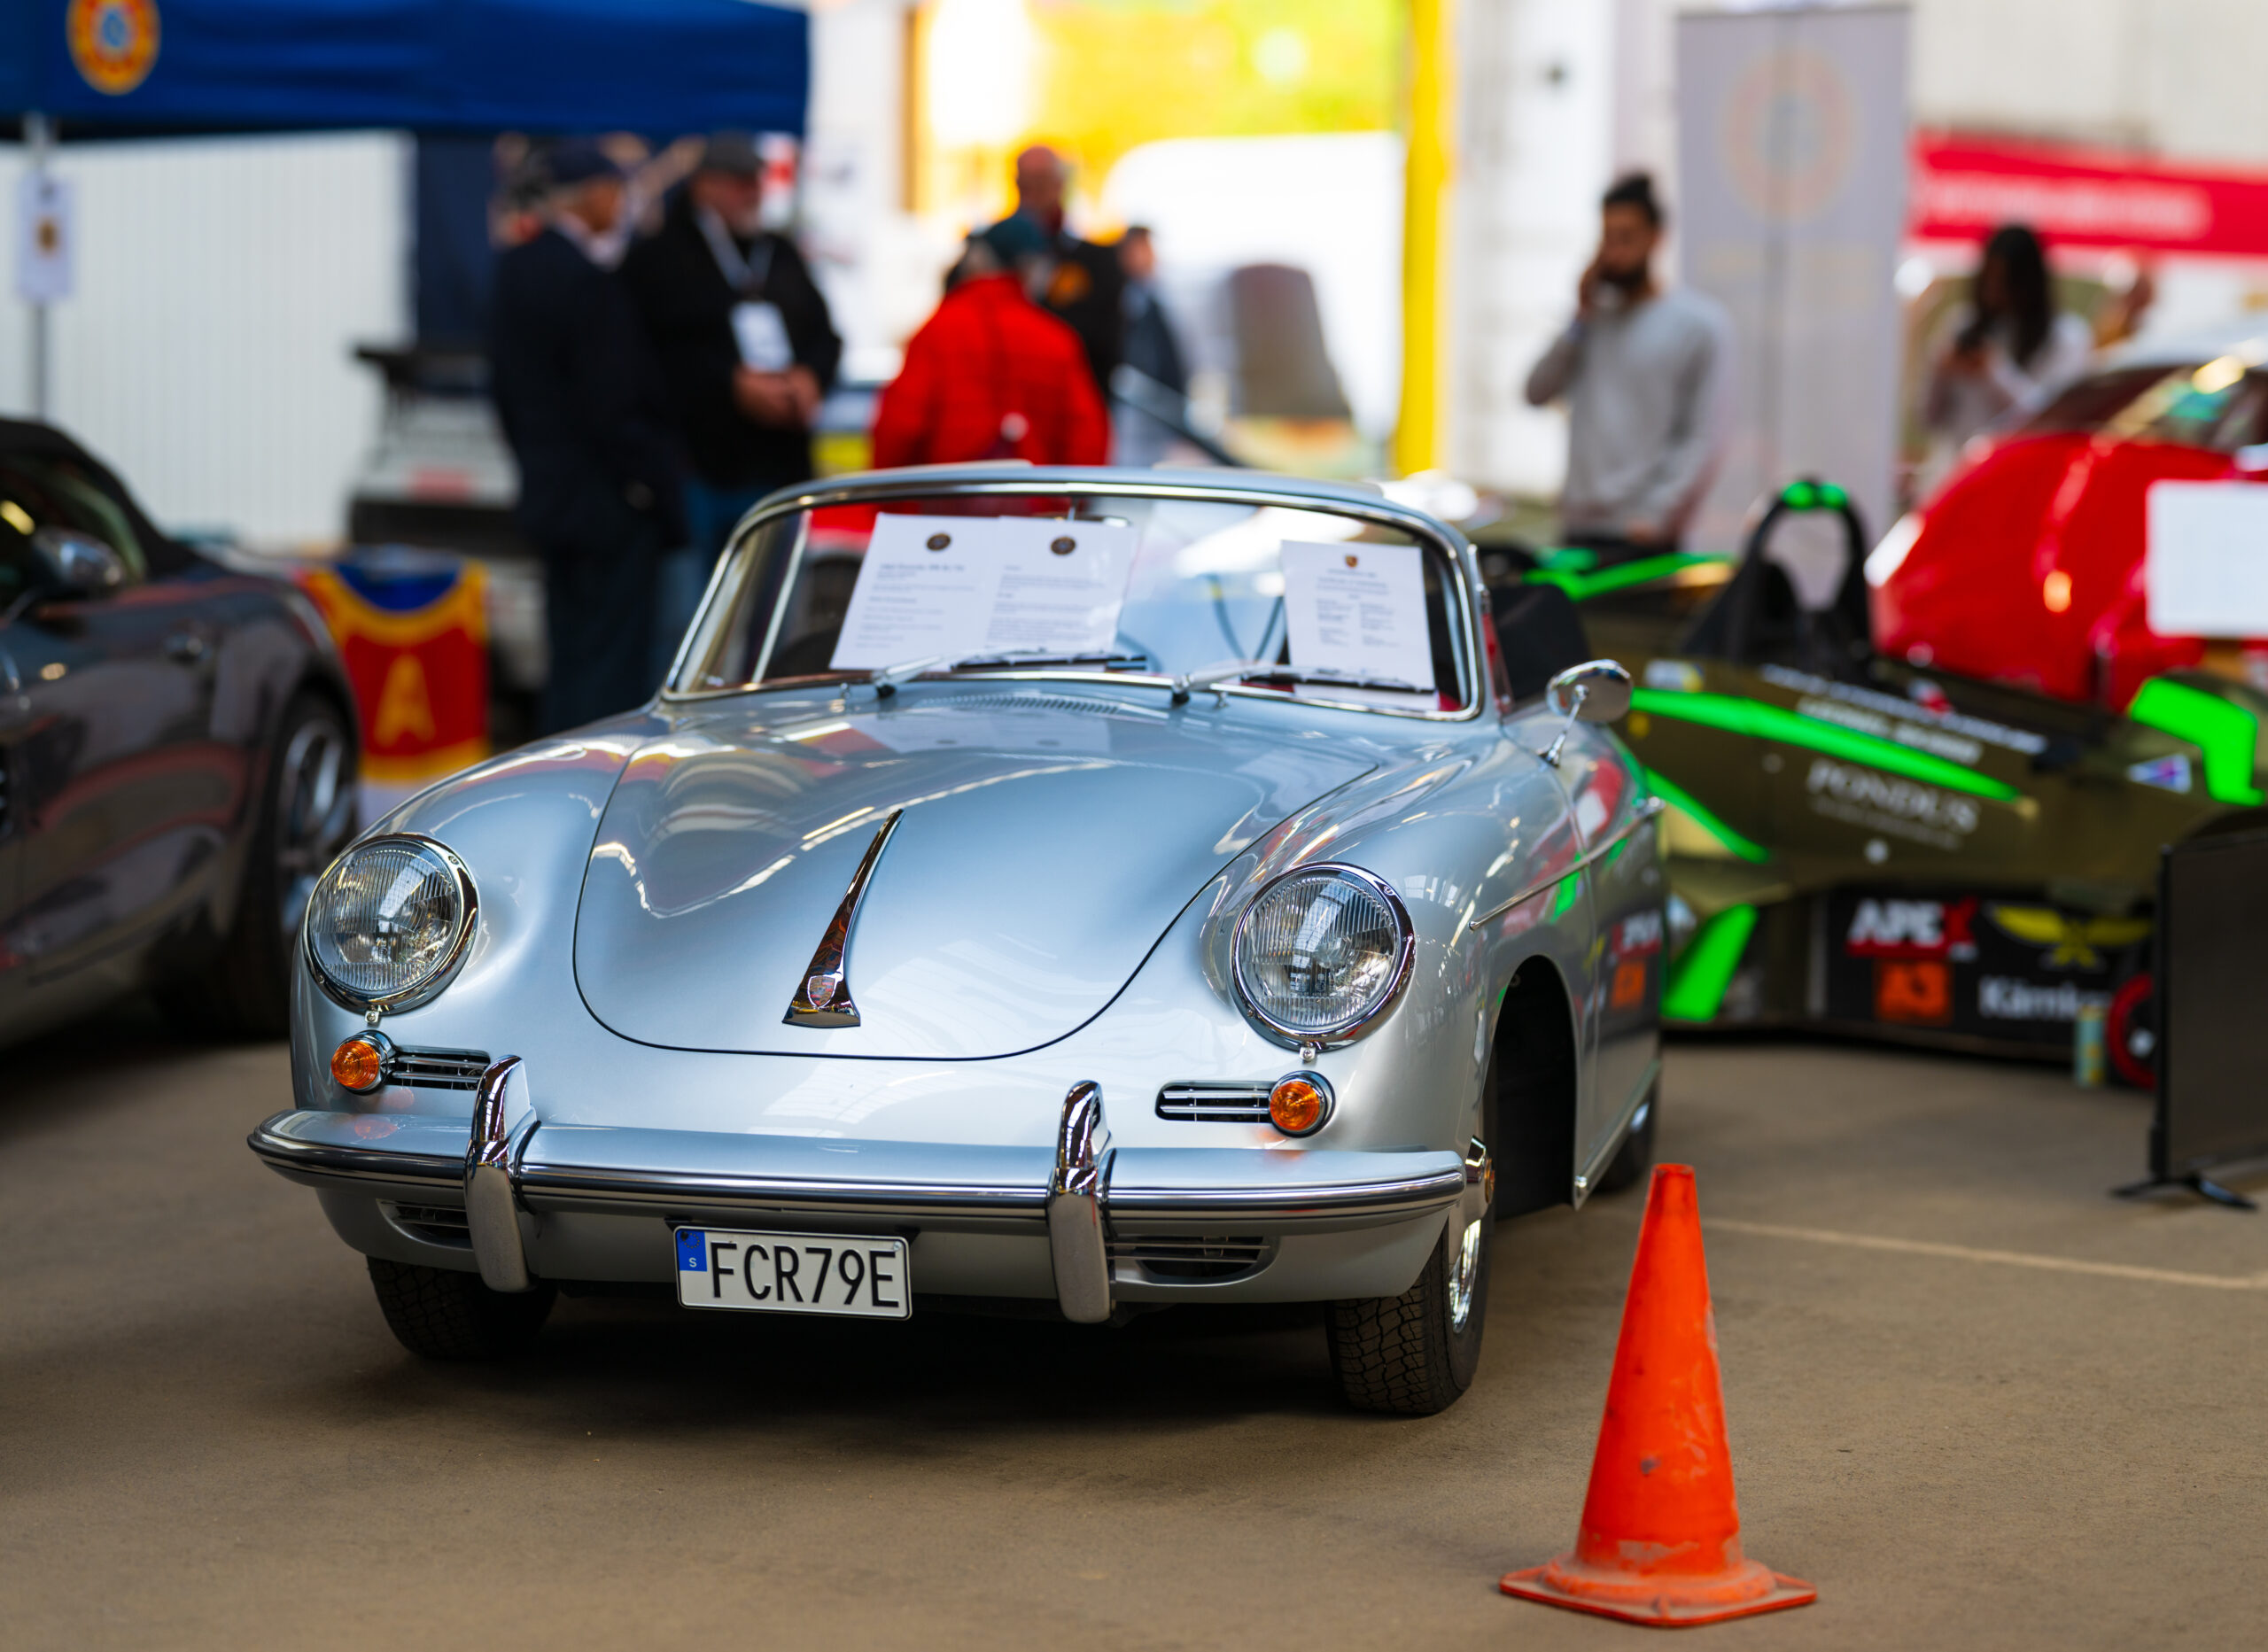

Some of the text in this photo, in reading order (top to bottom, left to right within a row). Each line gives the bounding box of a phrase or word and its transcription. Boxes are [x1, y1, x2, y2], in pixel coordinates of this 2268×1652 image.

[1806, 758, 1978, 834] PONDUS
[1847, 897, 1977, 947] APEX
[688, 1257, 698, 1268] S
[711, 1242, 899, 1307] FCR79E
